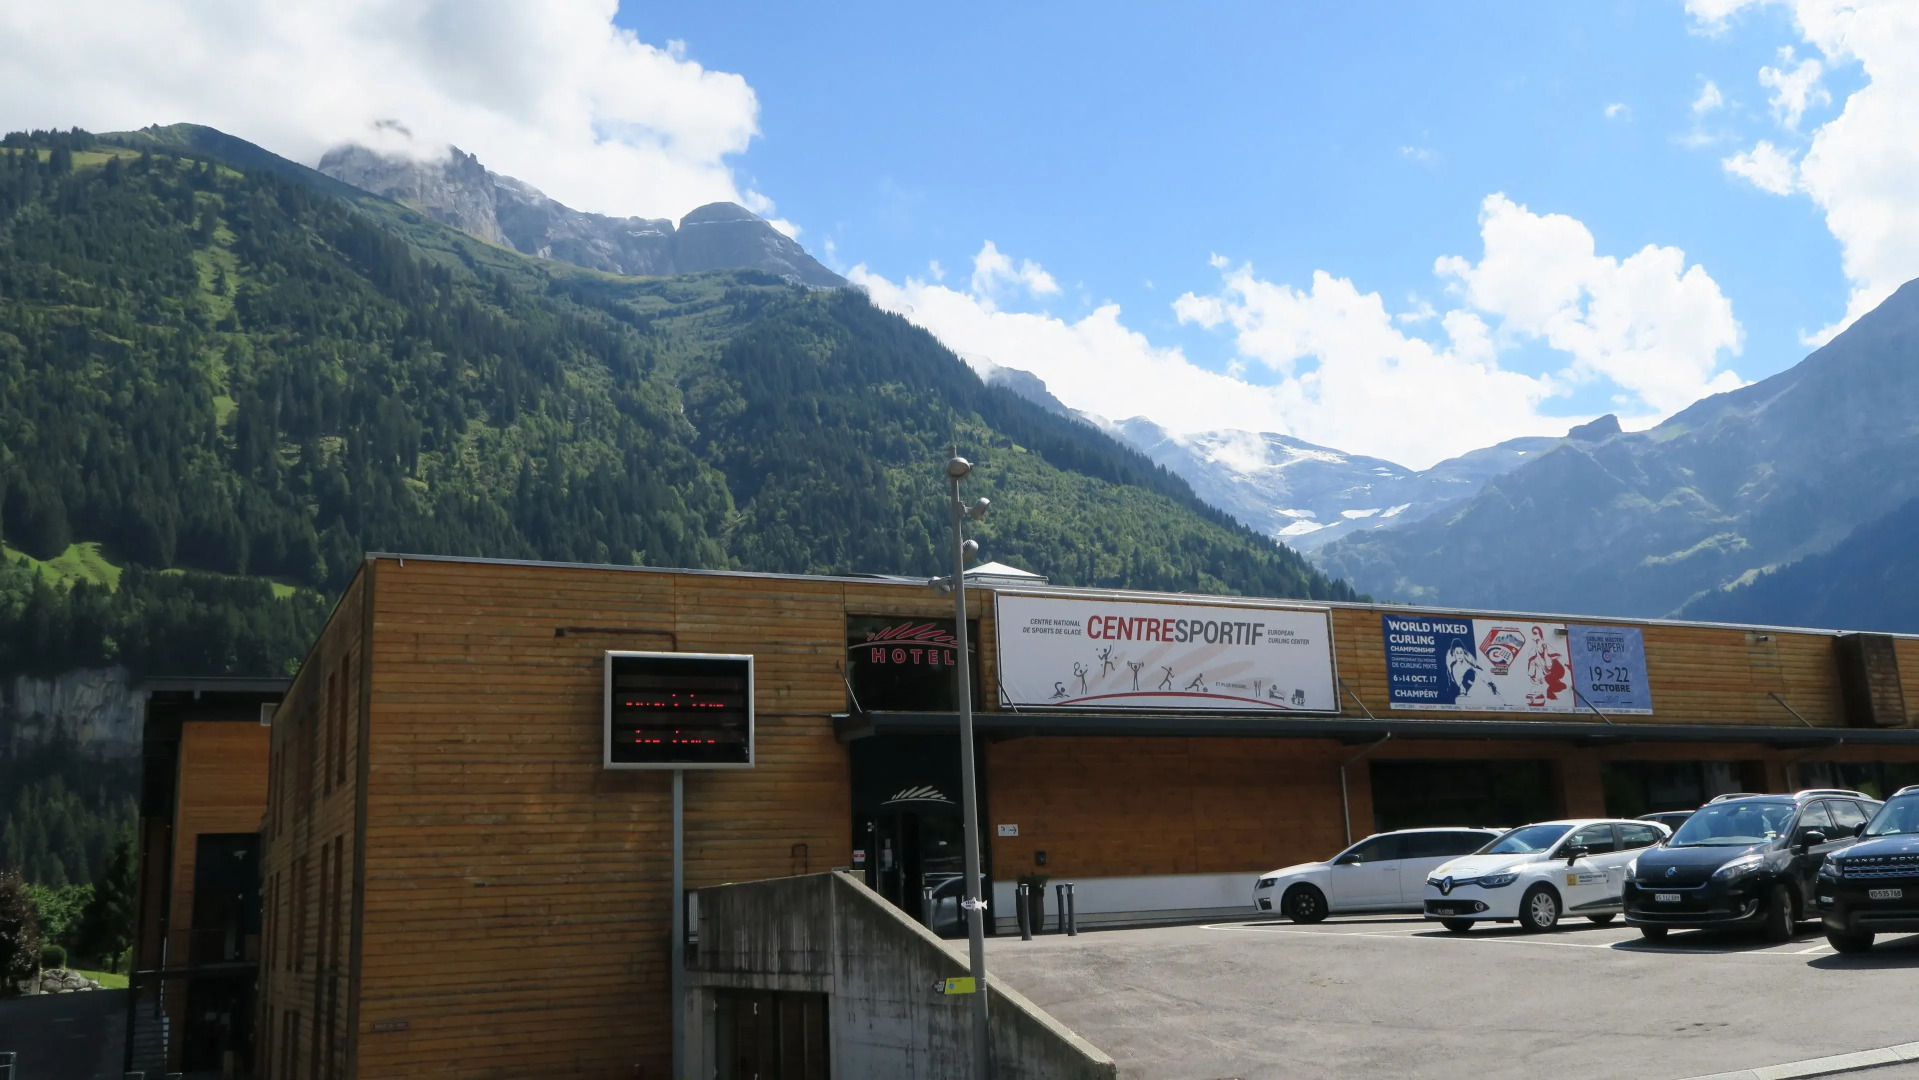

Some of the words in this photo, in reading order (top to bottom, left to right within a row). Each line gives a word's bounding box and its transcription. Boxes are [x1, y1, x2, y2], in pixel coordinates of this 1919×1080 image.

[1030, 618, 1052, 626] CENTRE
[1053, 619, 1081, 627] NATIONAL
[1031, 627, 1054, 635] SPORTS
[1063, 628, 1082, 636] GLACE
[1087, 615, 1265, 646] CENTRESPORTIF
[1389, 621, 1431, 633] WORLD
[1433, 623, 1468, 635] MIXED
[1268, 637, 1290, 645] CURLING
[1389, 634, 1435, 645] CURLING
[1390, 645, 1436, 654] CHAMPIONSHIP
[871, 647, 955, 666] HOTEL
[1411, 675, 1428, 683] OCT.
[1429, 675, 1437, 683] 17
[1394, 688, 1439, 698] CHAMPÉRY
[1592, 683, 1631, 693] OCTOBRE
